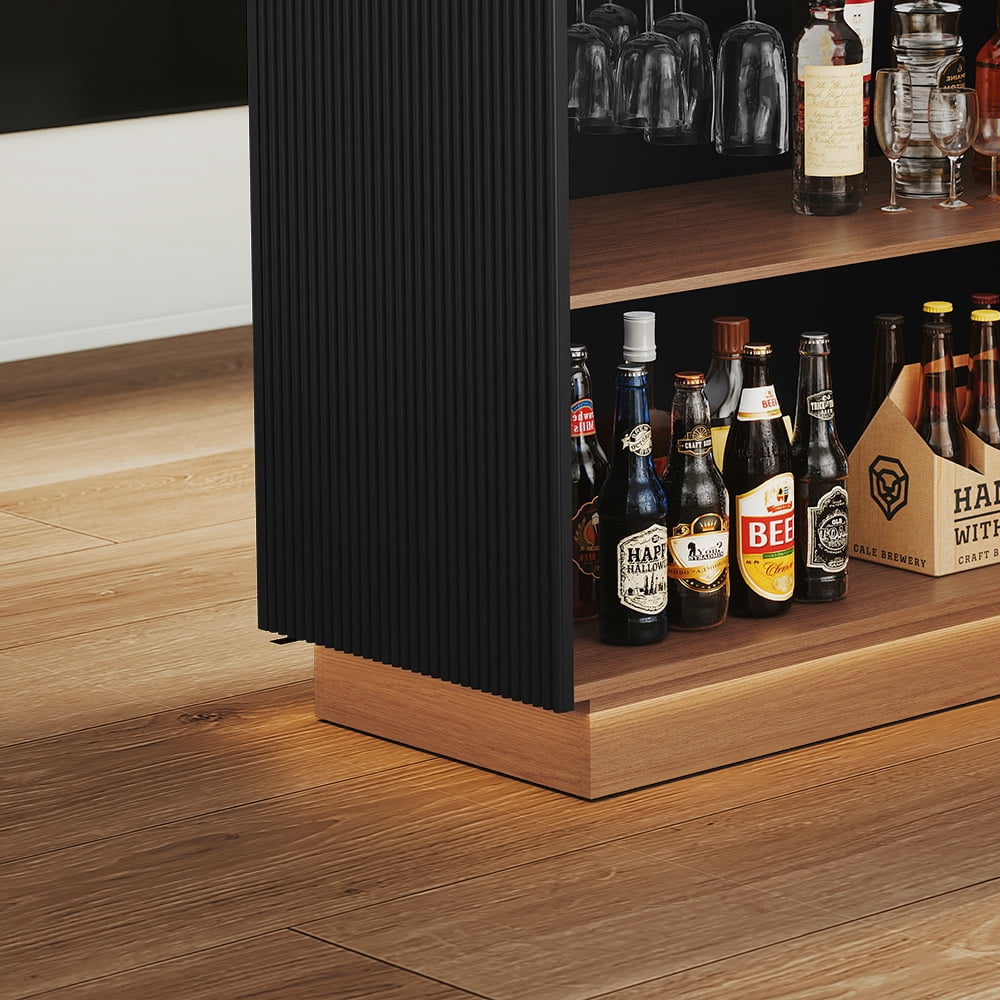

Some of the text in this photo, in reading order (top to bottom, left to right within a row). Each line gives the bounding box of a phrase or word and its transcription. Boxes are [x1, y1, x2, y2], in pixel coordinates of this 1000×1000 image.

[684, 441, 702, 449] CRAFT
[853, 543, 877, 558] CALE
[881, 549, 927, 568] BREWERY
[958, 549, 990, 565] CRAFT
